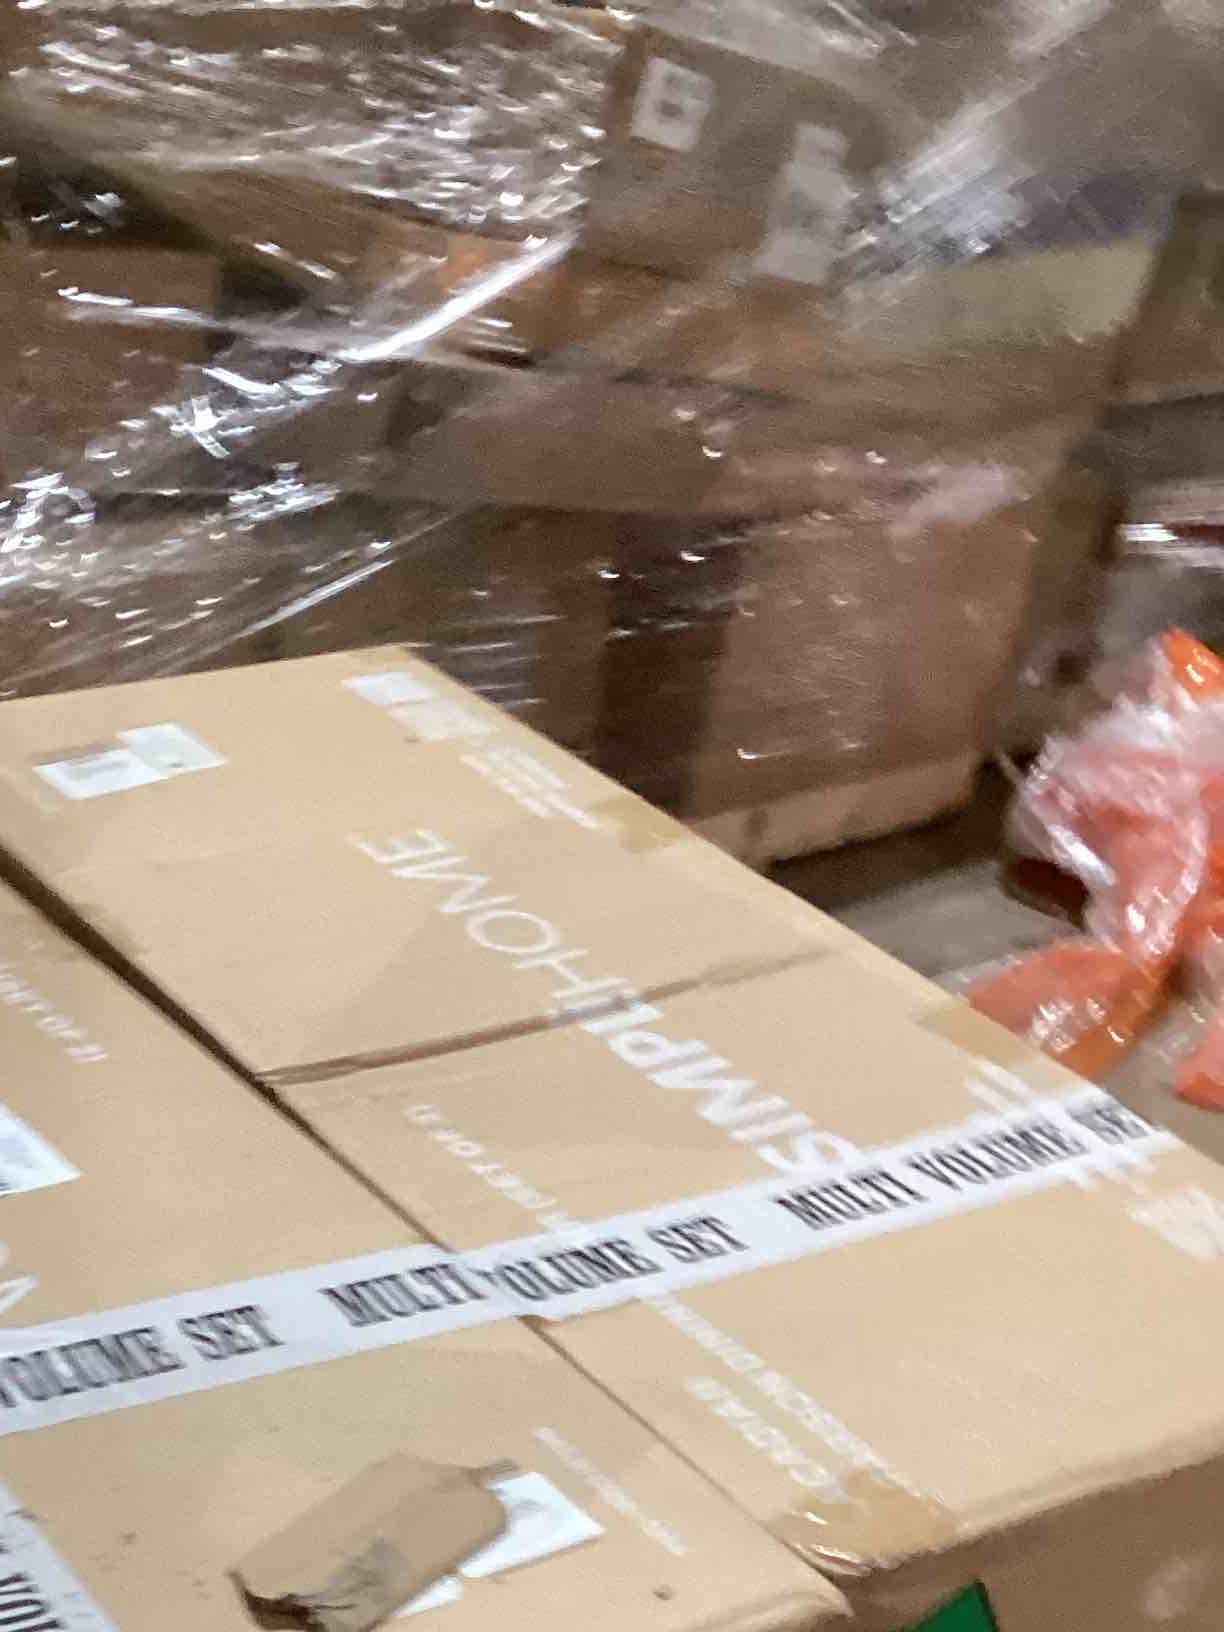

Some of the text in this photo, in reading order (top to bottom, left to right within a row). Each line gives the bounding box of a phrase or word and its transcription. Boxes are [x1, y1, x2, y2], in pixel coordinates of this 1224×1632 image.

[176, 1304, 286, 1364] SET
[316, 1260, 492, 1329] MULTI
[644, 1214, 752, 1266] SET
[774, 1168, 931, 1232] MULTI
[898, 1118, 1092, 1193] VOLUME
